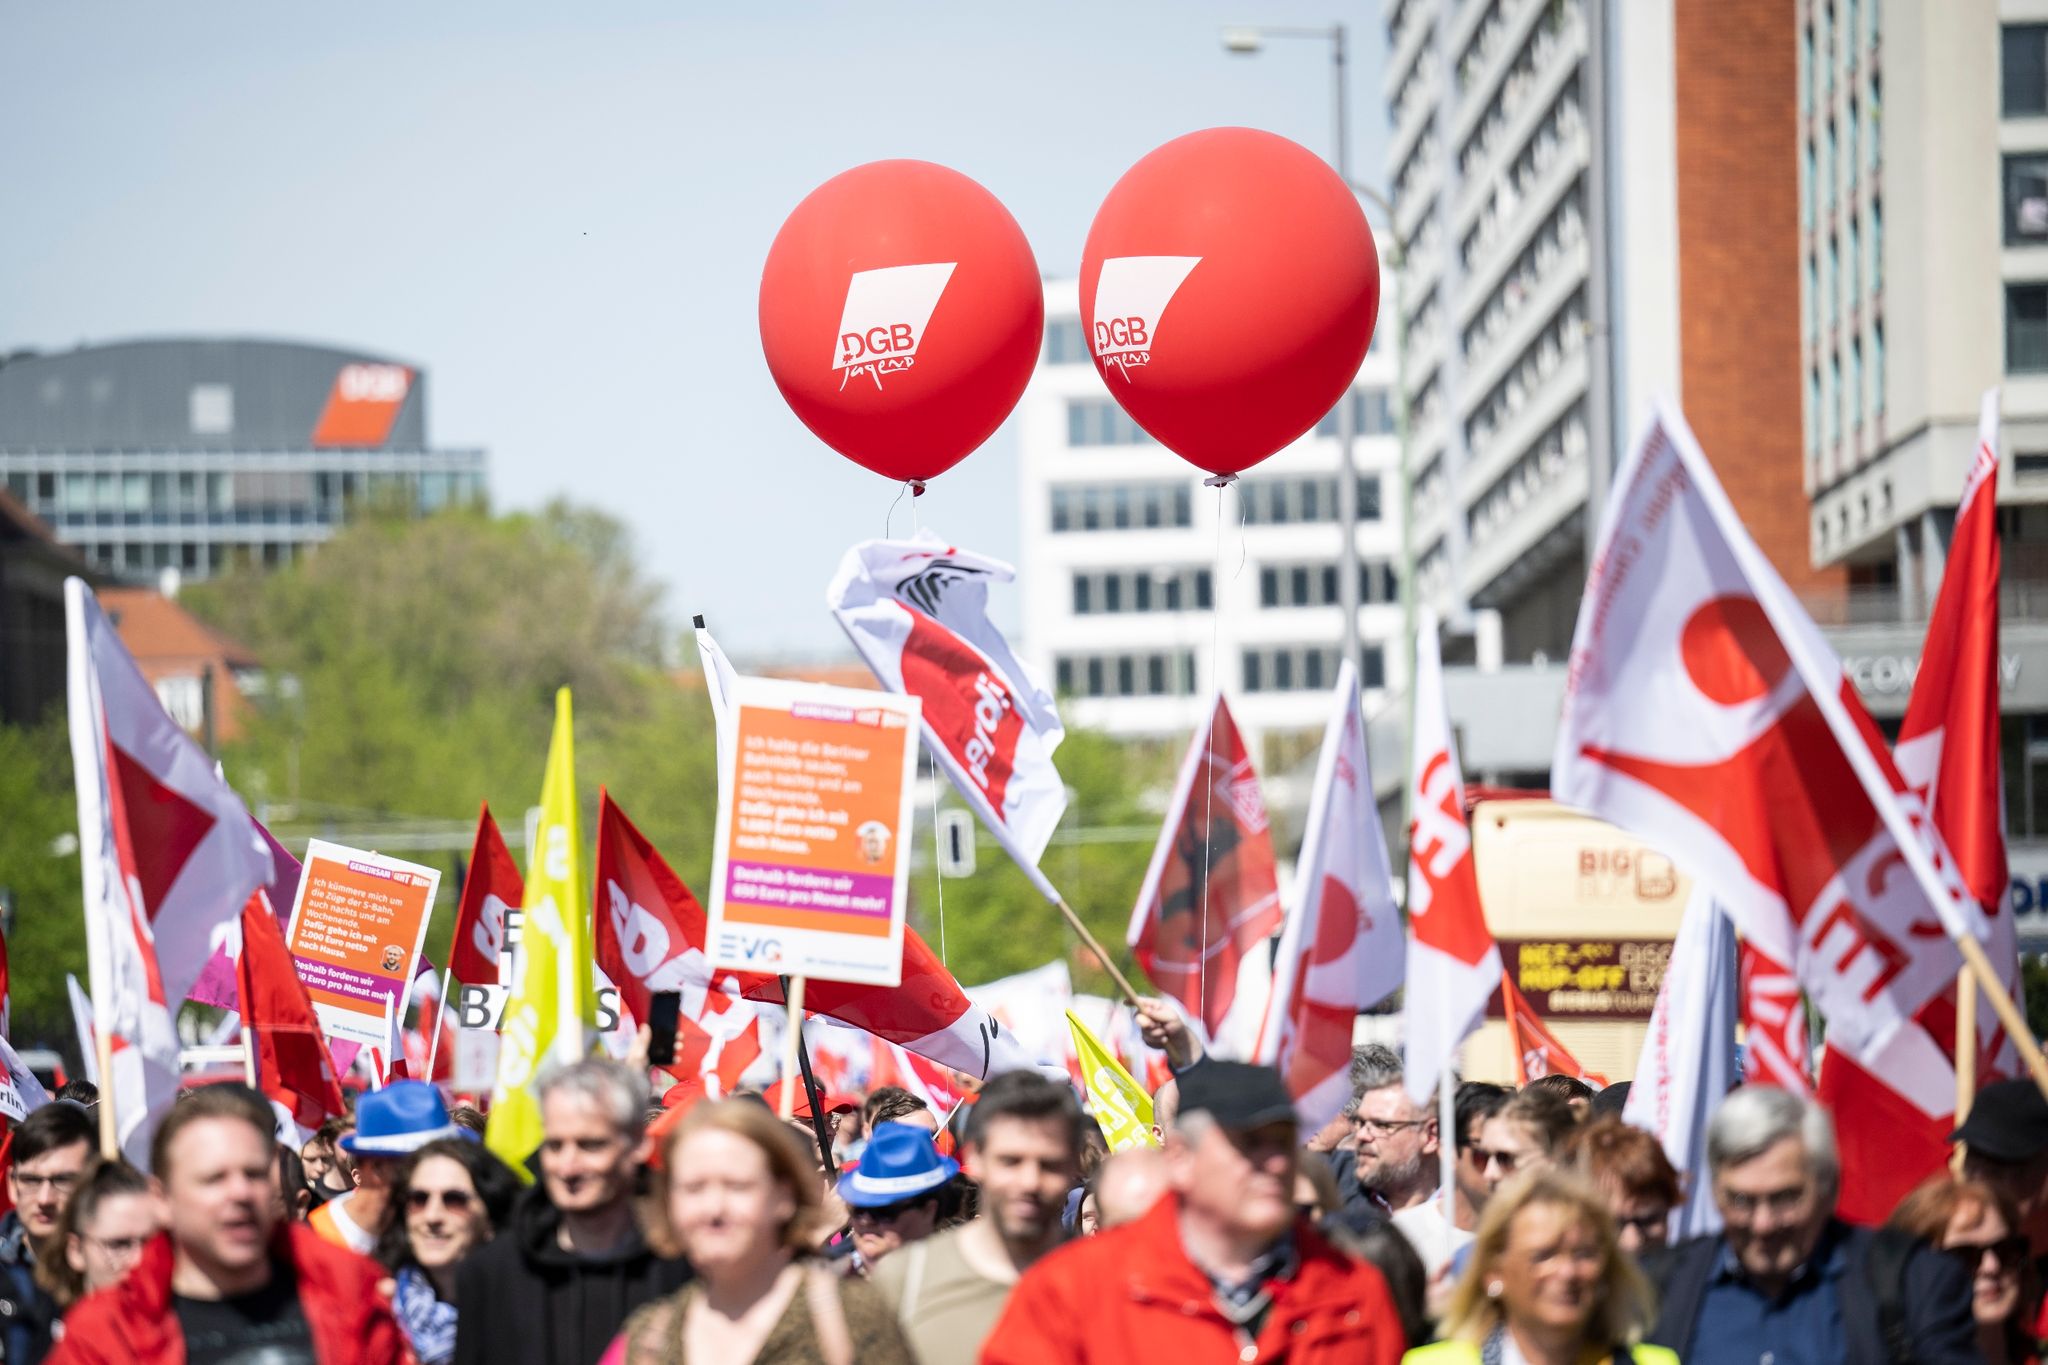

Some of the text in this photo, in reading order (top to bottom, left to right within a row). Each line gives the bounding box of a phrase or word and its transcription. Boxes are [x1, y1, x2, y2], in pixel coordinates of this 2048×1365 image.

[841, 323, 914, 360] DGB
[1096, 317, 1148, 349] DGB
[822, 744, 870, 761] Berliner
[311, 888, 394, 917] die Züge der S-Bahn,
[314, 878, 403, 906] Ich kümmere mich um
[306, 909, 360, 929] Wochenende.
[309, 900, 390, 925] auch nachts und am
[301, 929, 368, 952] 2.000 Euro netto
[304, 919, 378, 944] Dafür gehe ich mit
[298, 940, 347, 959] nach Hause.
[720, 933, 782, 962] EVG
[295, 960, 374, 987] Deshalb fordern wir
[308, 974, 326, 986] Euro
[327, 980, 343, 991] pro
[343, 984, 370, 997] Monat
[371, 990, 395, 1001] meh
